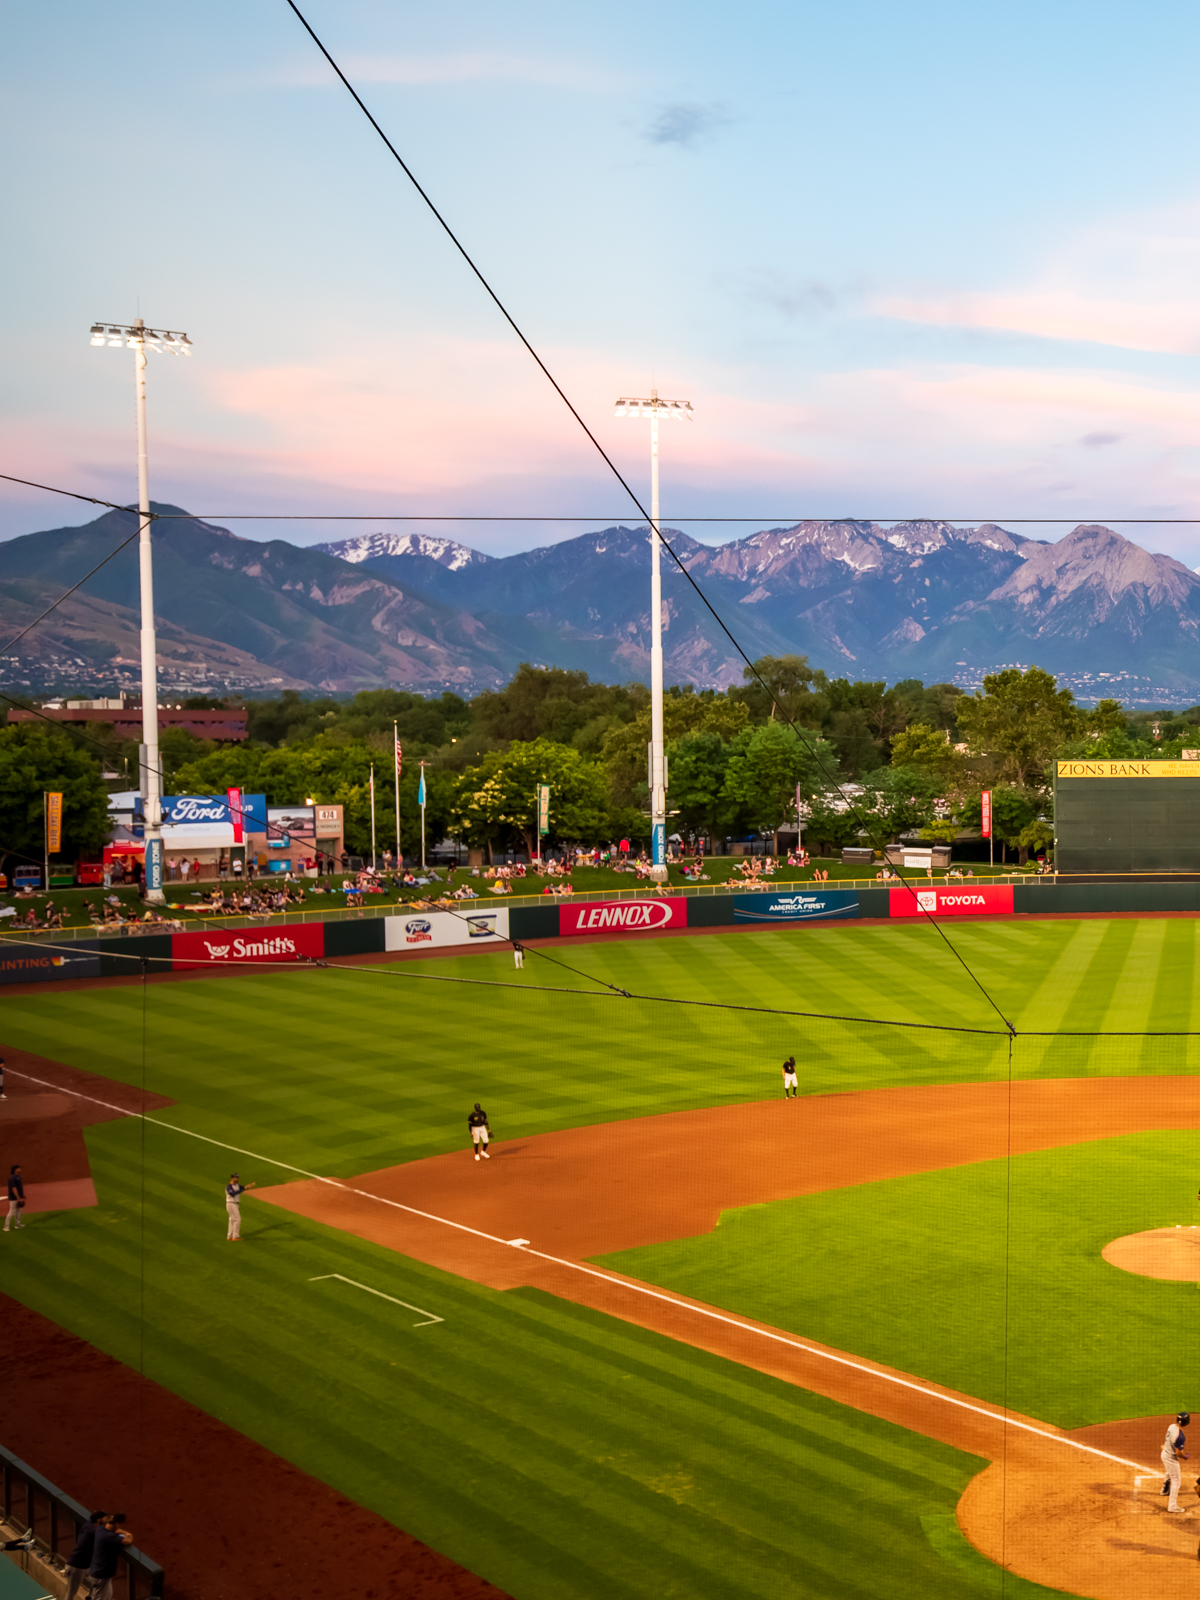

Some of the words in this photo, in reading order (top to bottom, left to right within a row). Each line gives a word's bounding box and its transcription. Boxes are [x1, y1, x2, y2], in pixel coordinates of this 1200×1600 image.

[1059, 764, 1104, 775] ZIONS
[1110, 764, 1151, 775] BANK
[171, 798, 225, 820] Ford
[152, 841, 160, 864] ZONE
[153, 865, 161, 888] FORD
[940, 896, 985, 905] TOYOTA
[576, 905, 653, 929] LENNOX
[233, 937, 295, 958] Smith's
[0, 957, 50, 970] INTING
